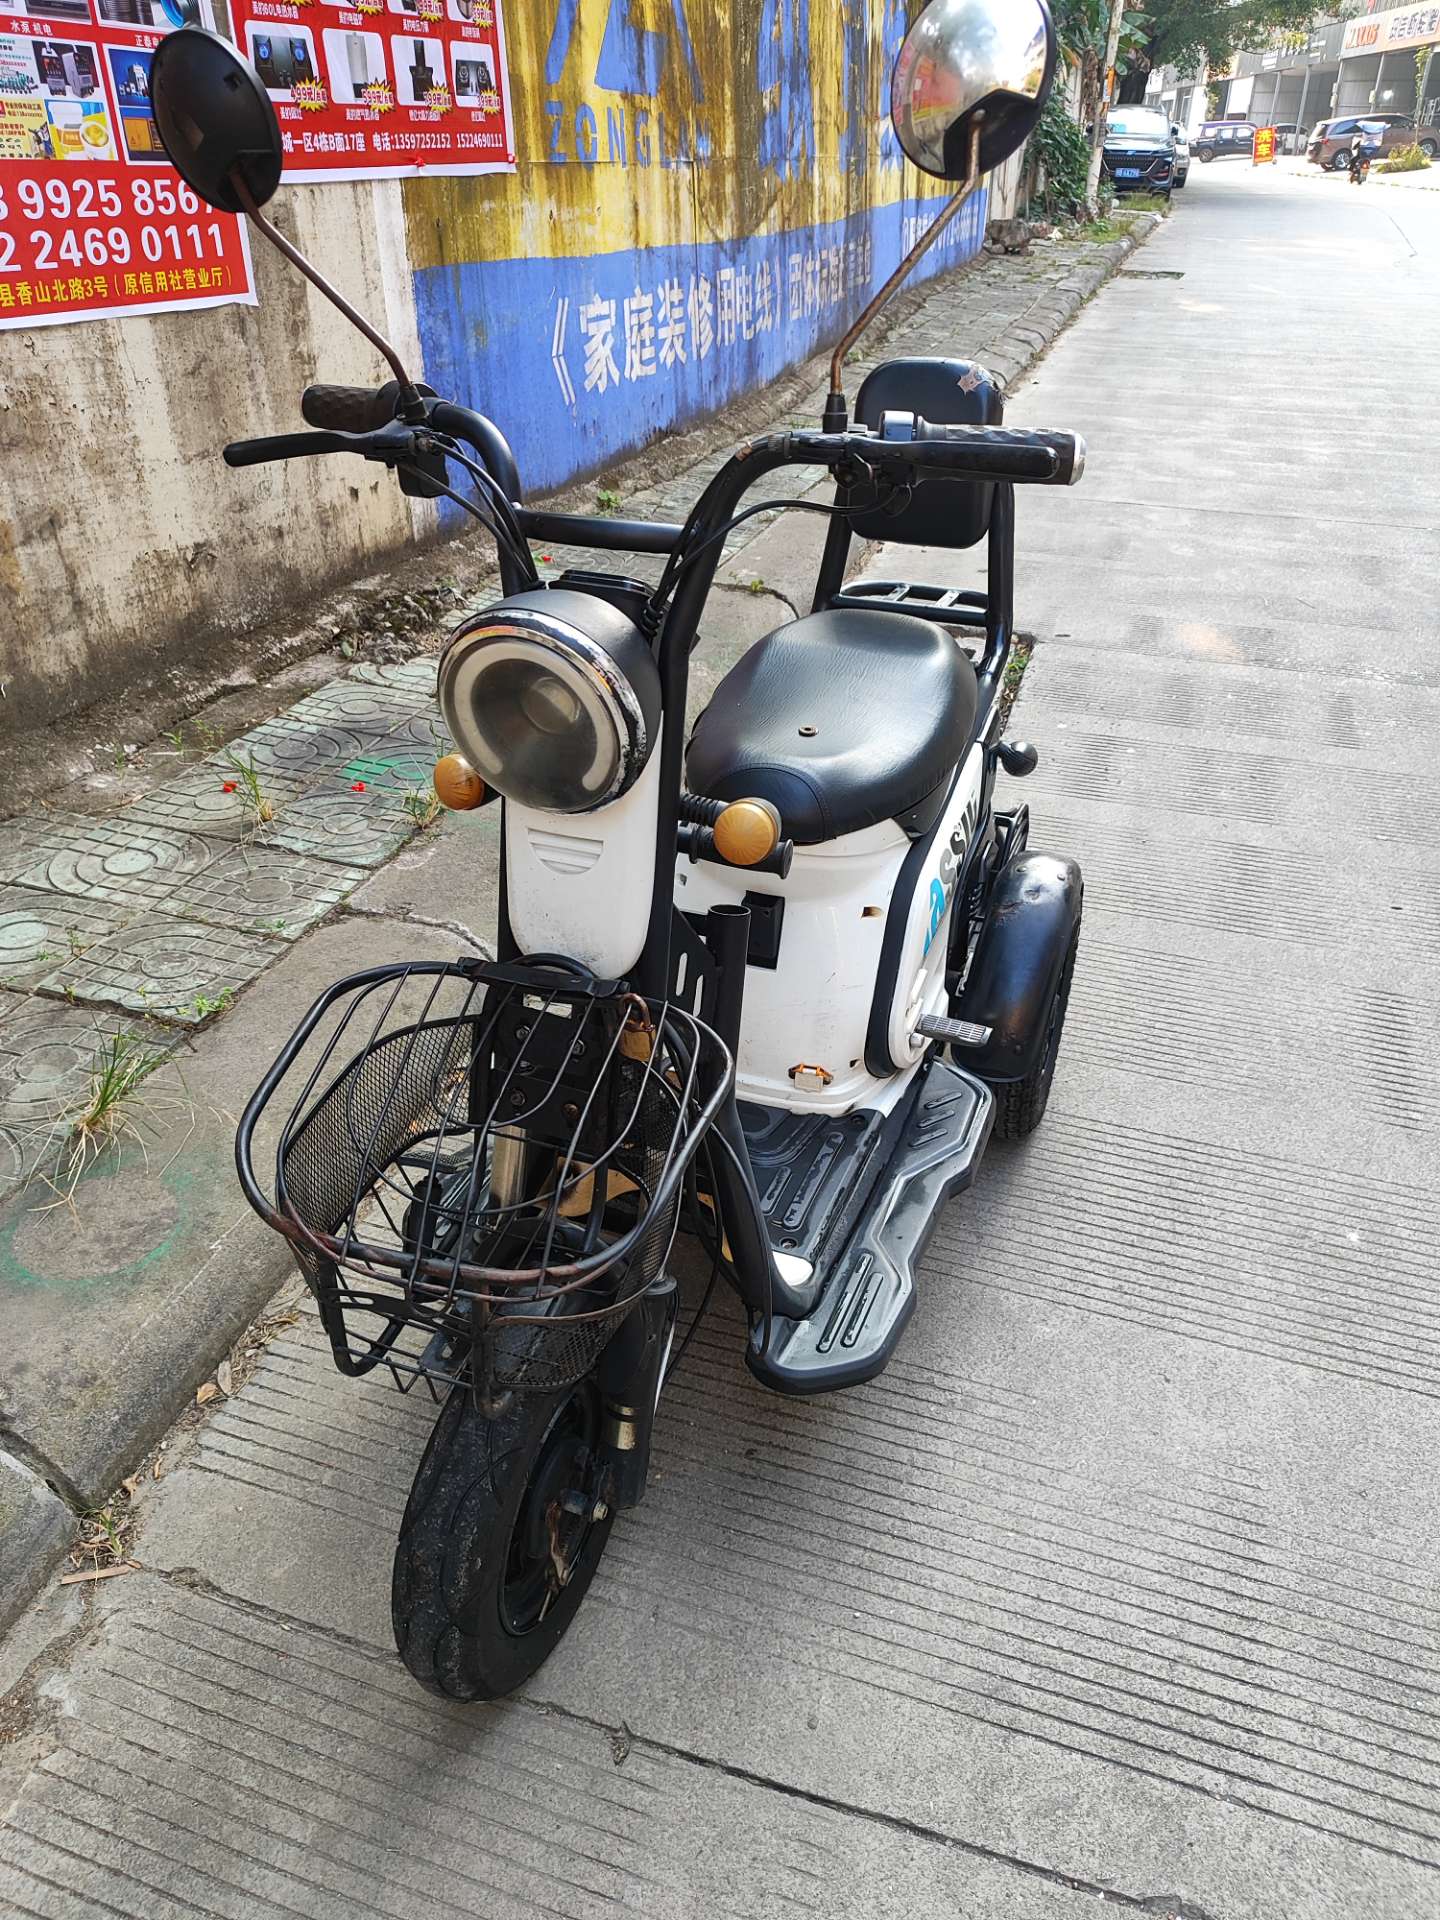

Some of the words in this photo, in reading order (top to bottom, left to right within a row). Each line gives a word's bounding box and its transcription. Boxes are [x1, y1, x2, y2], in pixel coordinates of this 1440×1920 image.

[10, 20, 31, 33] 水泵
[33, 22, 53, 35] 机电
[135, 34, 163, 48] 正泰电
[456, 133, 503, 148] 15224690111
[17, 178, 122, 220] 9925
[131, 178, 214, 216] 856
[30, 227, 131, 270] 2469
[141, 223, 225, 262] 0111
